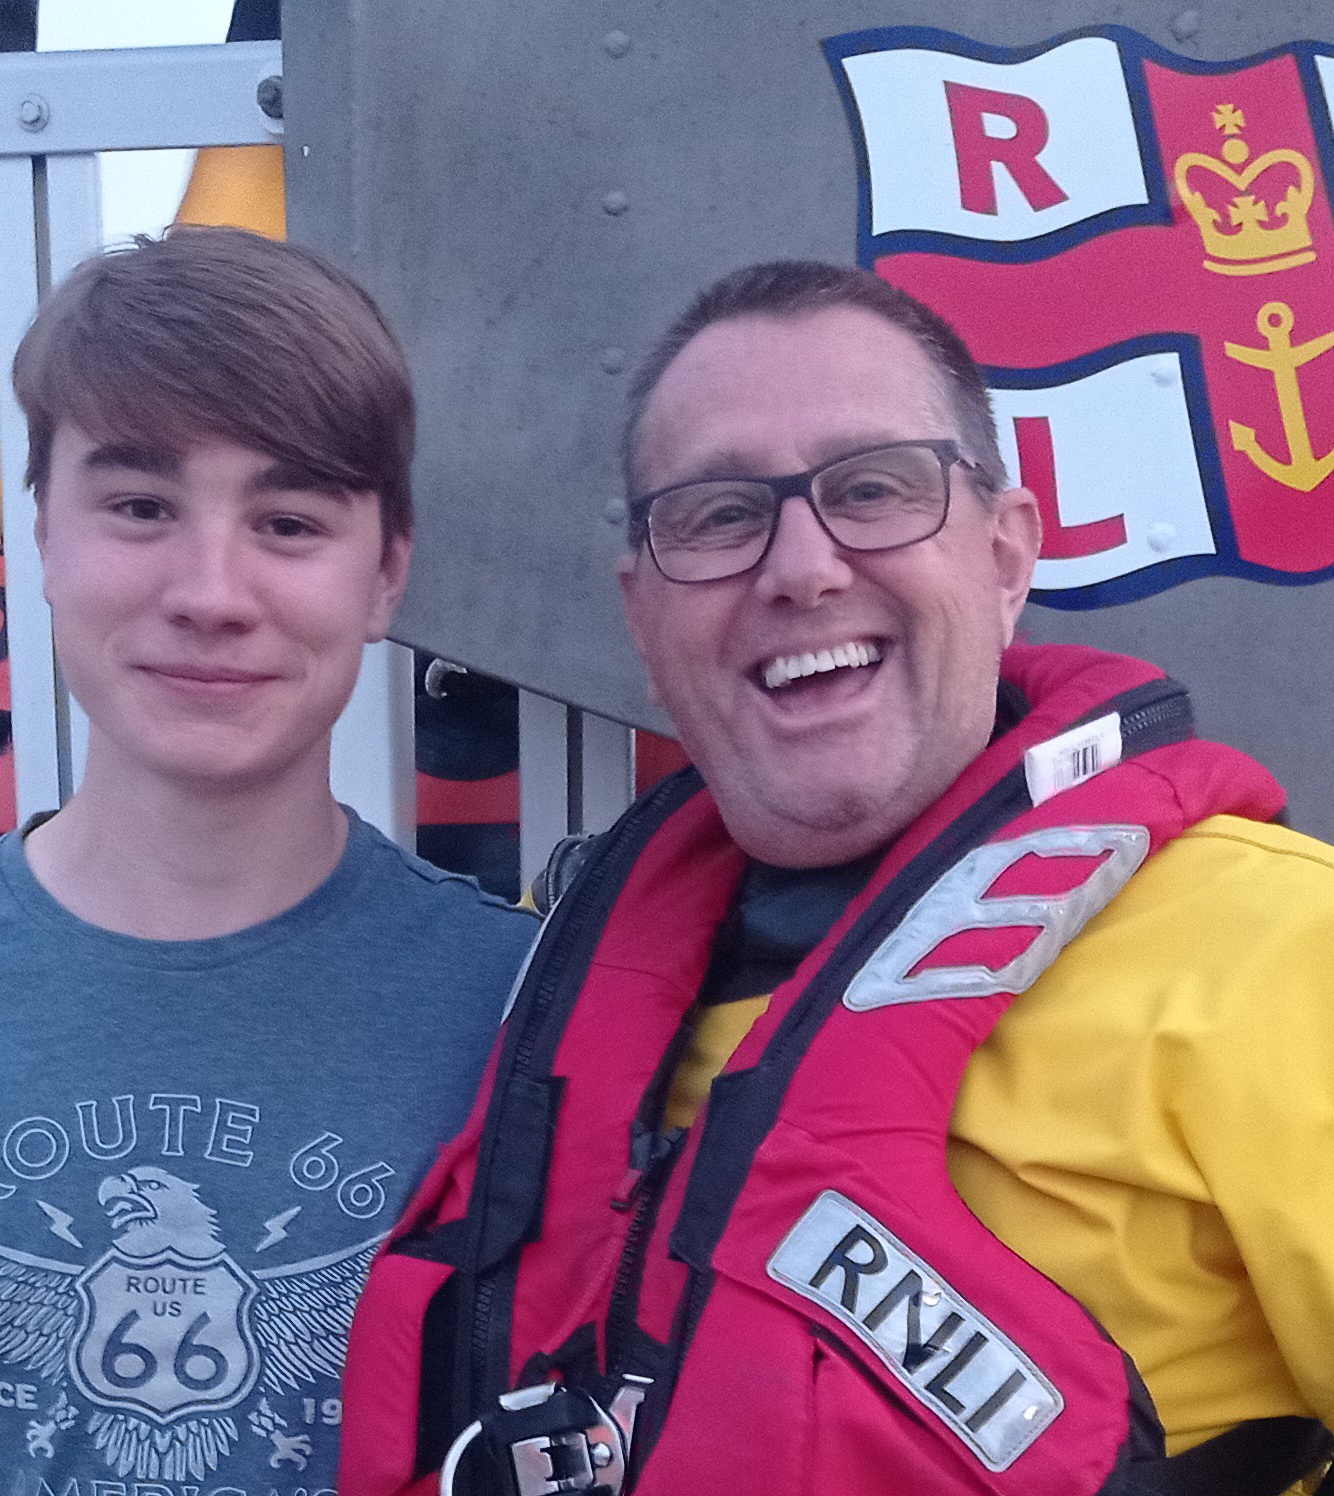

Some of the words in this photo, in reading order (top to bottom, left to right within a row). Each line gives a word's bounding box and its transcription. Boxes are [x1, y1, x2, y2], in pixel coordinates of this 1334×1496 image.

[943, 80, 1069, 215] R
[1013, 417, 1128, 560] L
[289, 1132, 397, 1219] 66
[125, 1276, 207, 1295] ROUTE
[154, 1300, 182, 1318] US
[808, 1223, 1027, 1434] RNLI
[101, 1310, 229, 1389] 66
